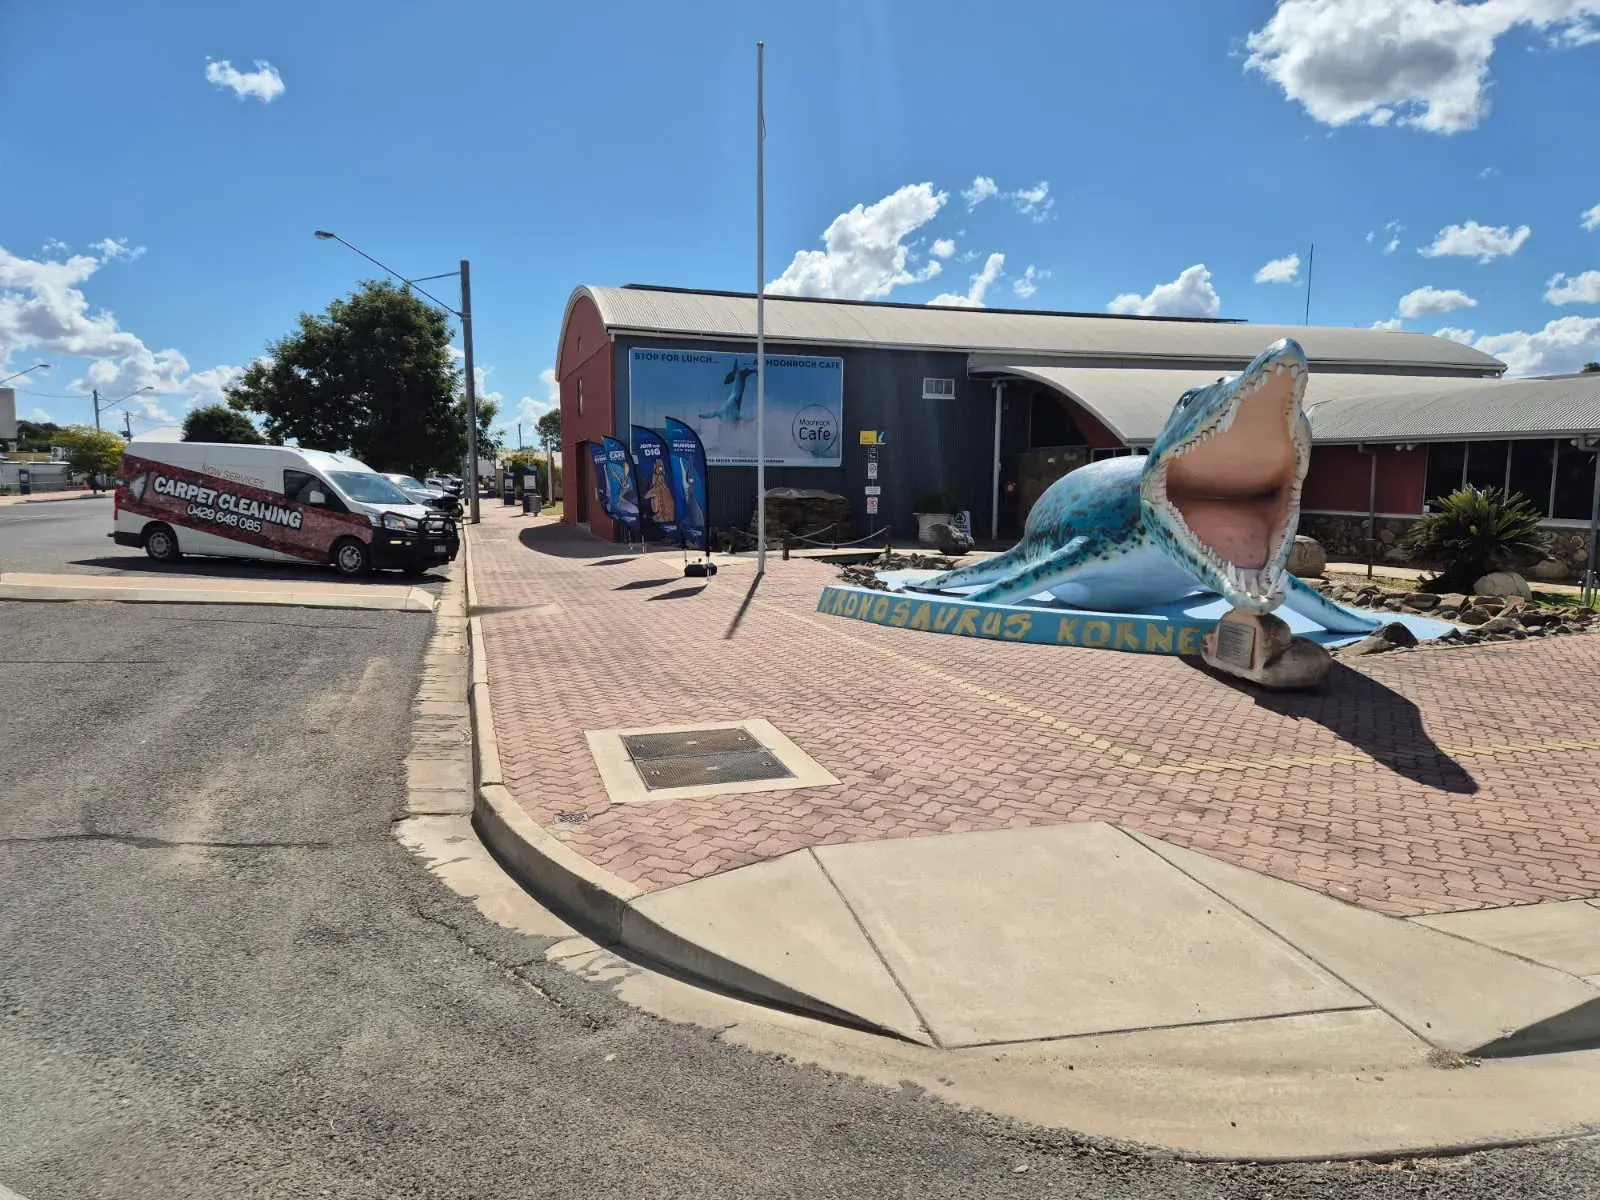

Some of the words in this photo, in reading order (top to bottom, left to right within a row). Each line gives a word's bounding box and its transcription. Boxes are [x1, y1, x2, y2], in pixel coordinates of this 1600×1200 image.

[635, 353, 659, 361] STOP
[661, 354, 680, 363] FOR
[766, 359, 817, 369] MOONROCK
[818, 360, 840, 370] CAFE
[799, 426, 831, 441] Cafe
[644, 448, 661, 456] DIG
[202, 463, 221, 477] NOW
[222, 470, 265, 488] SERVICES
[154, 475, 218, 505] CARPET
[217, 493, 302, 529] CLEANING
[187, 503, 215, 520] 0429
[215, 511, 238, 527] 648
[238, 517, 262, 533] 085
[819, 588, 1033, 639] KRONOSAURUS
[1057, 617, 1203, 655] KORNE
